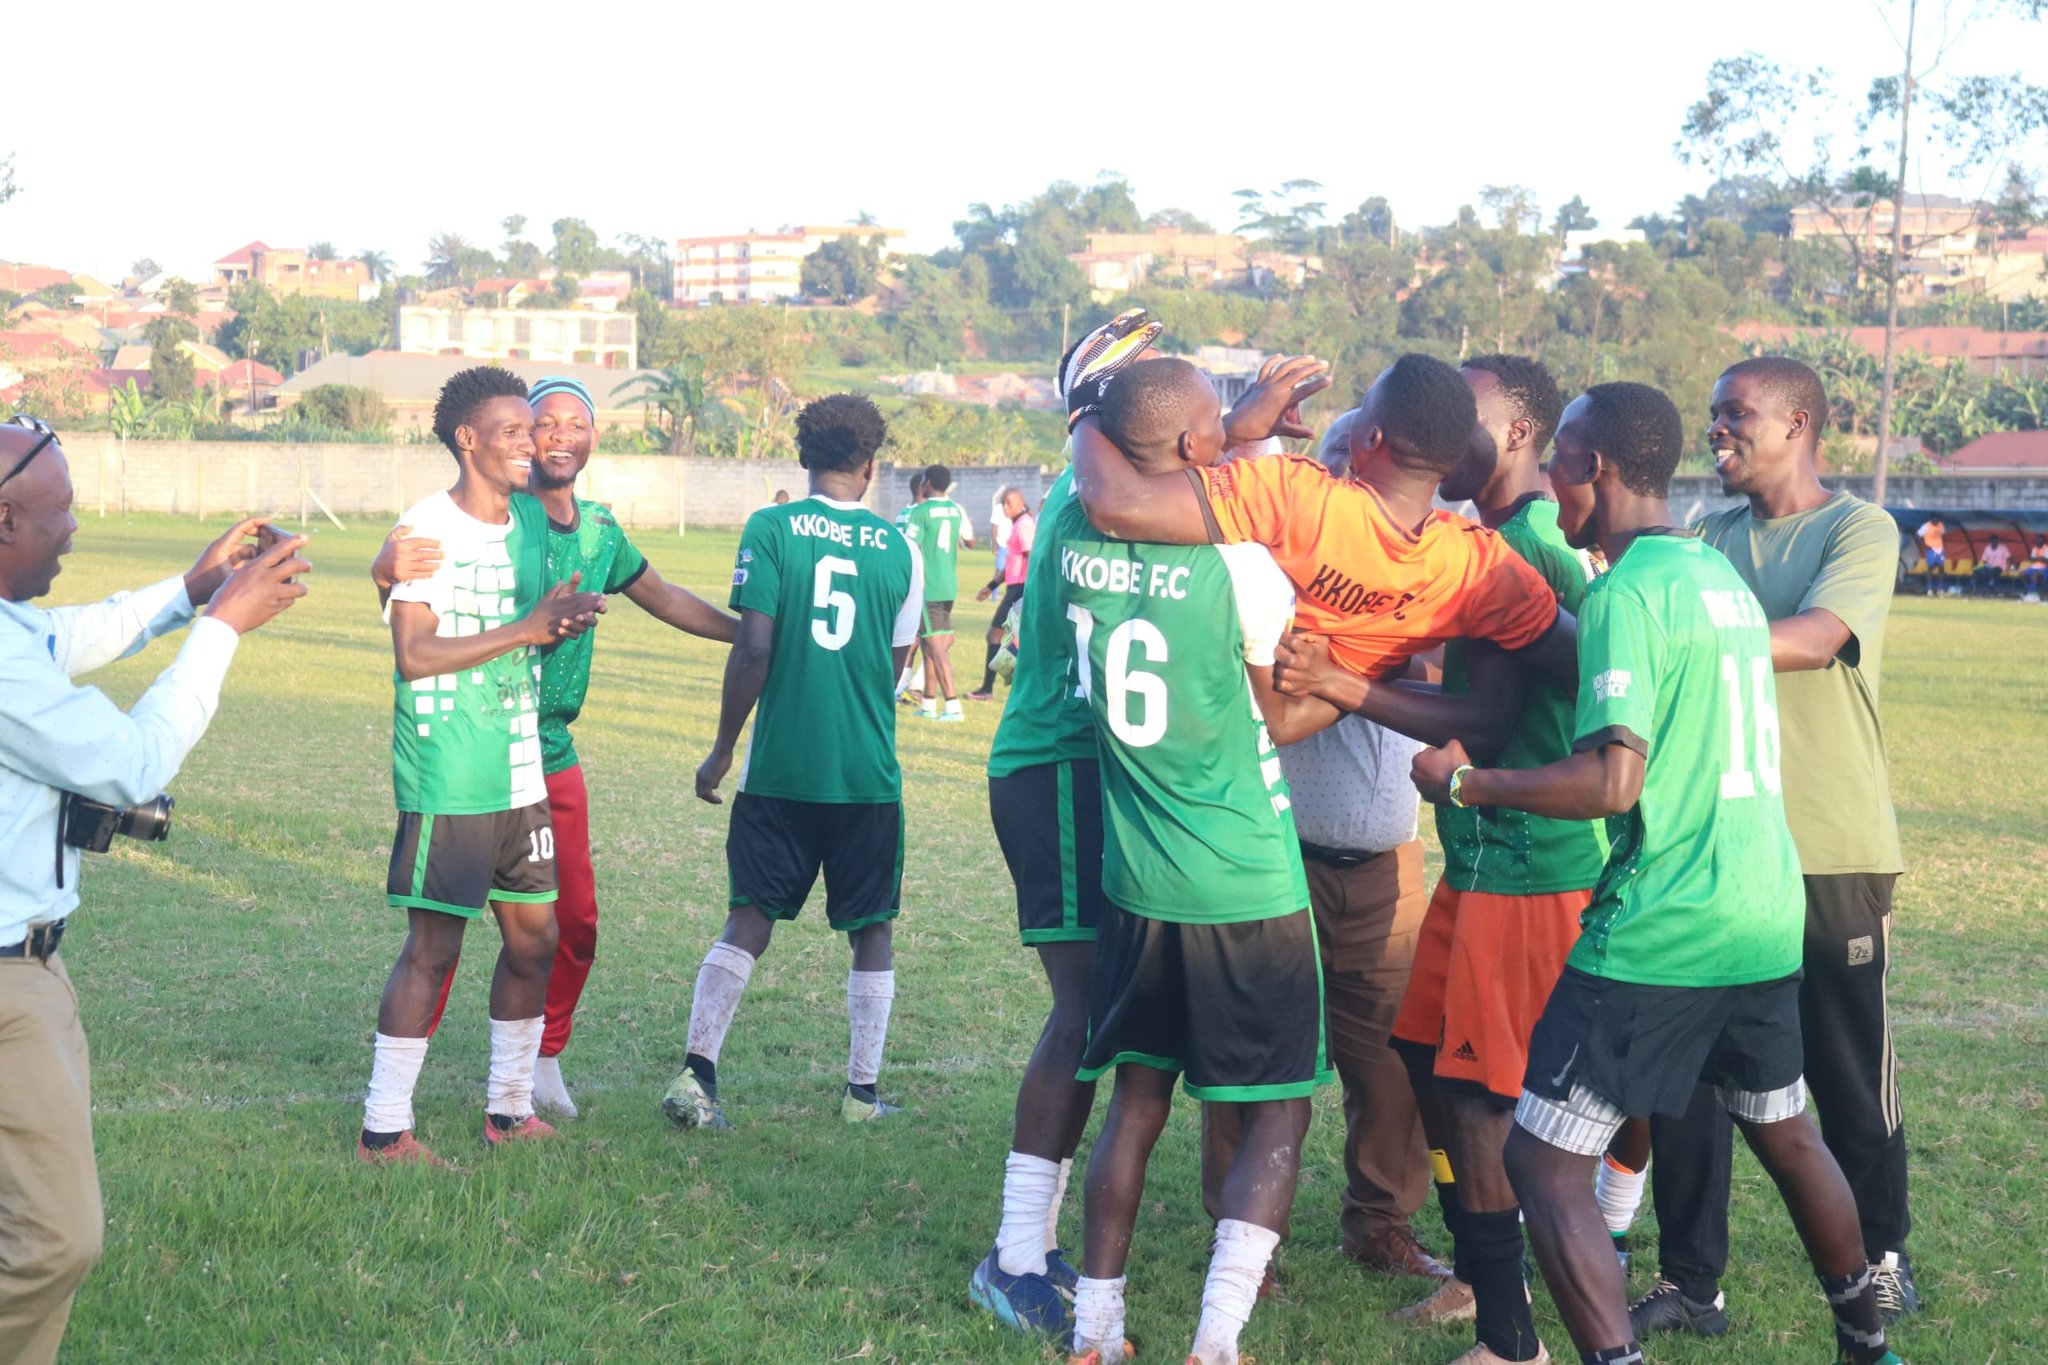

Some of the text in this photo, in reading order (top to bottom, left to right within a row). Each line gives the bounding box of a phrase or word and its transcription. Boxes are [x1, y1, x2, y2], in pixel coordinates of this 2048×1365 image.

[789, 514, 888, 550] KKOBE F.C
[811, 555, 858, 651] 5
[1061, 546, 1190, 600] KKOBE F.C
[1066, 602, 1168, 747] 16
[1720, 655, 1781, 800] 16
[528, 827, 554, 862] 10
